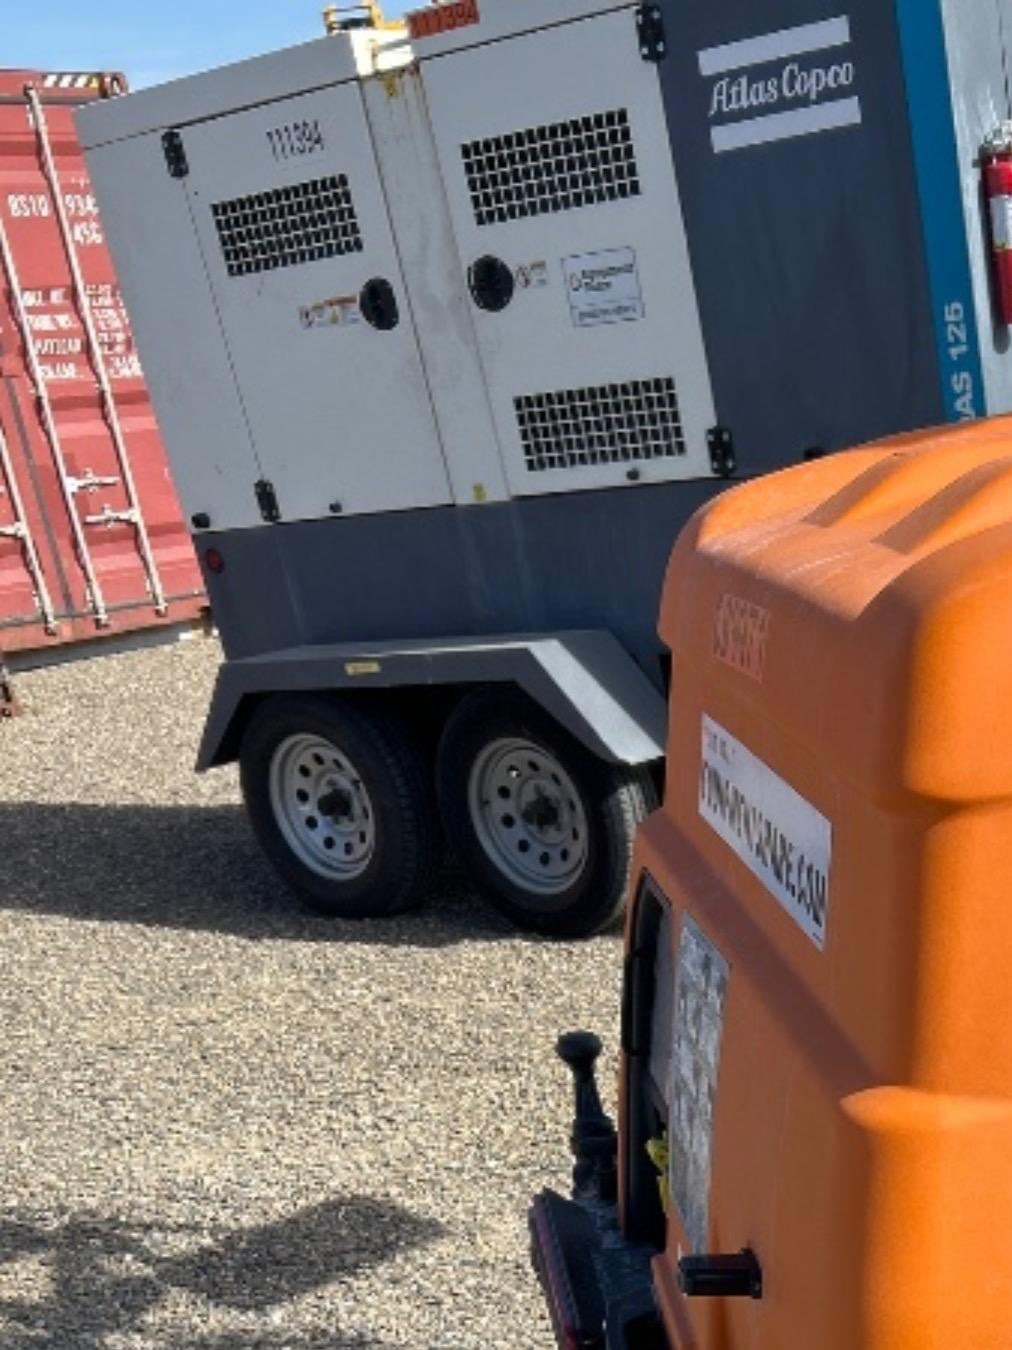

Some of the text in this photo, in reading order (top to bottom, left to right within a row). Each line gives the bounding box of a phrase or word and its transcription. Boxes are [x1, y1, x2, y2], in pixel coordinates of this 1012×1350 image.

[708, 62, 854, 118] Atlas Copco
[944, 301, 968, 361] 125
